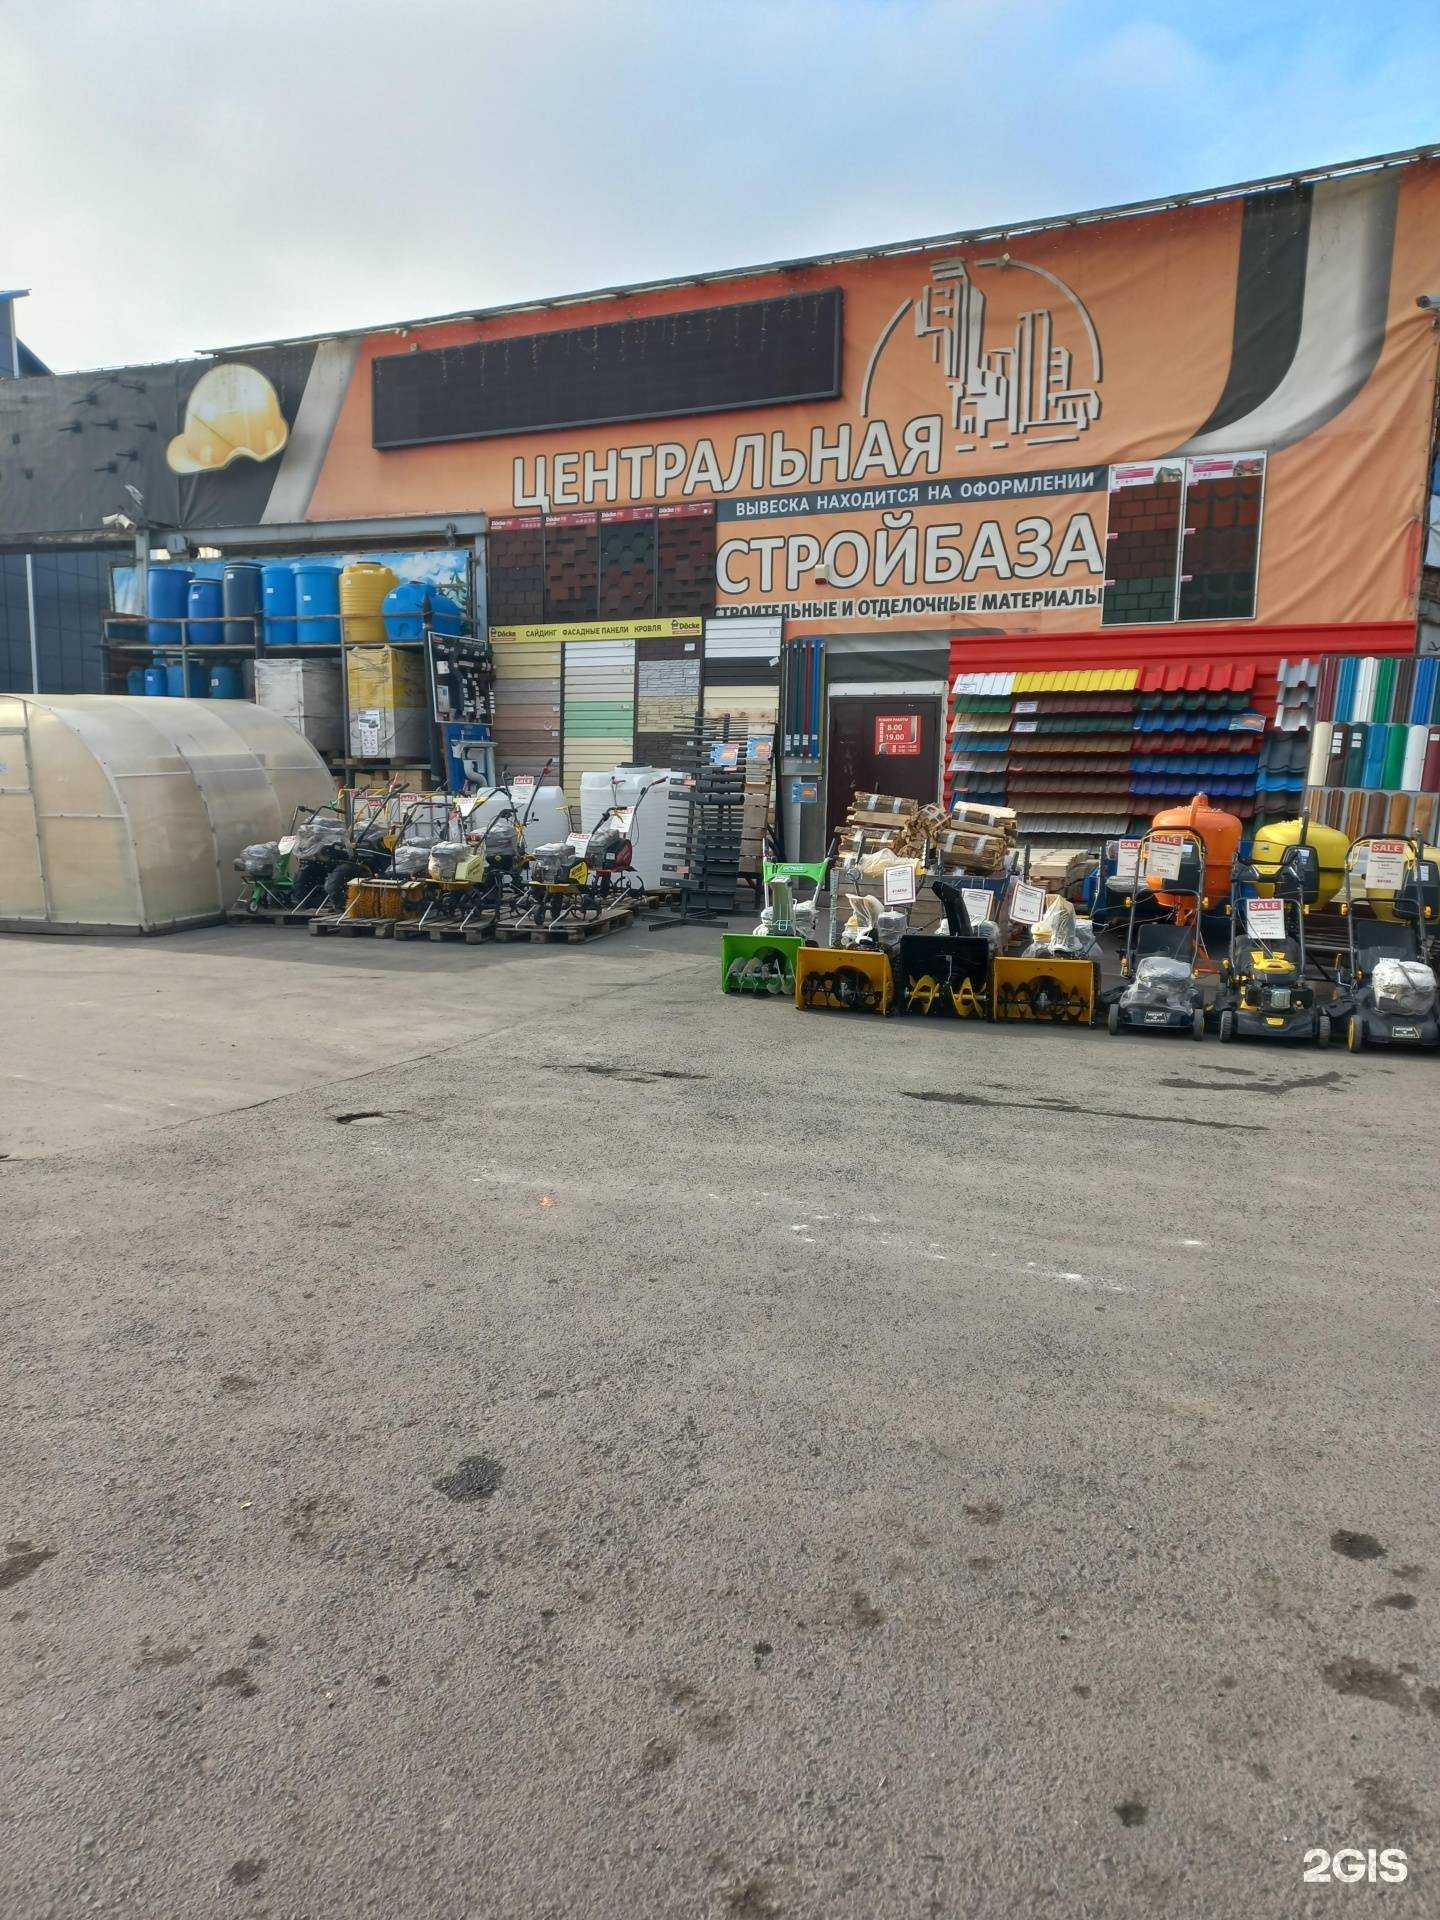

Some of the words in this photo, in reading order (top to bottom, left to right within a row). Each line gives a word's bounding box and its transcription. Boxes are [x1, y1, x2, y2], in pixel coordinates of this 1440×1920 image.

[512, 414, 943, 513] ЦЕНТРАЛЬНАЯ
[736, 493, 810, 516] ВЫВЕСКА
[817, 487, 919, 511] НАХОДИТСЯ
[928, 481, 953, 501] НА
[961, 472, 1095, 498] ОФОРМЛЕНИИ
[714, 511, 1104, 595] СТРОЙБАЗА
[714, 600, 837, 619] СТРОИТЕЛЬНЫЕ
[842, 601, 853, 616] И
[858, 594, 977, 618] ОТДЕЛОЧНЫЕ
[982, 587, 1103, 610] МАТЕРИАЛЫ
[525, 628, 557, 638] САЙДИНГ
[562, 626, 600, 637] ФАСАДНЫЕ
[602, 625, 629, 635] ПАНЕЛИ
[634, 624, 662, 633] КРОВЛЯ
[1154, 836, 1181, 846] SALE
[1373, 844, 1401, 852] SALE
[1250, 902, 1279, 910] SALE
